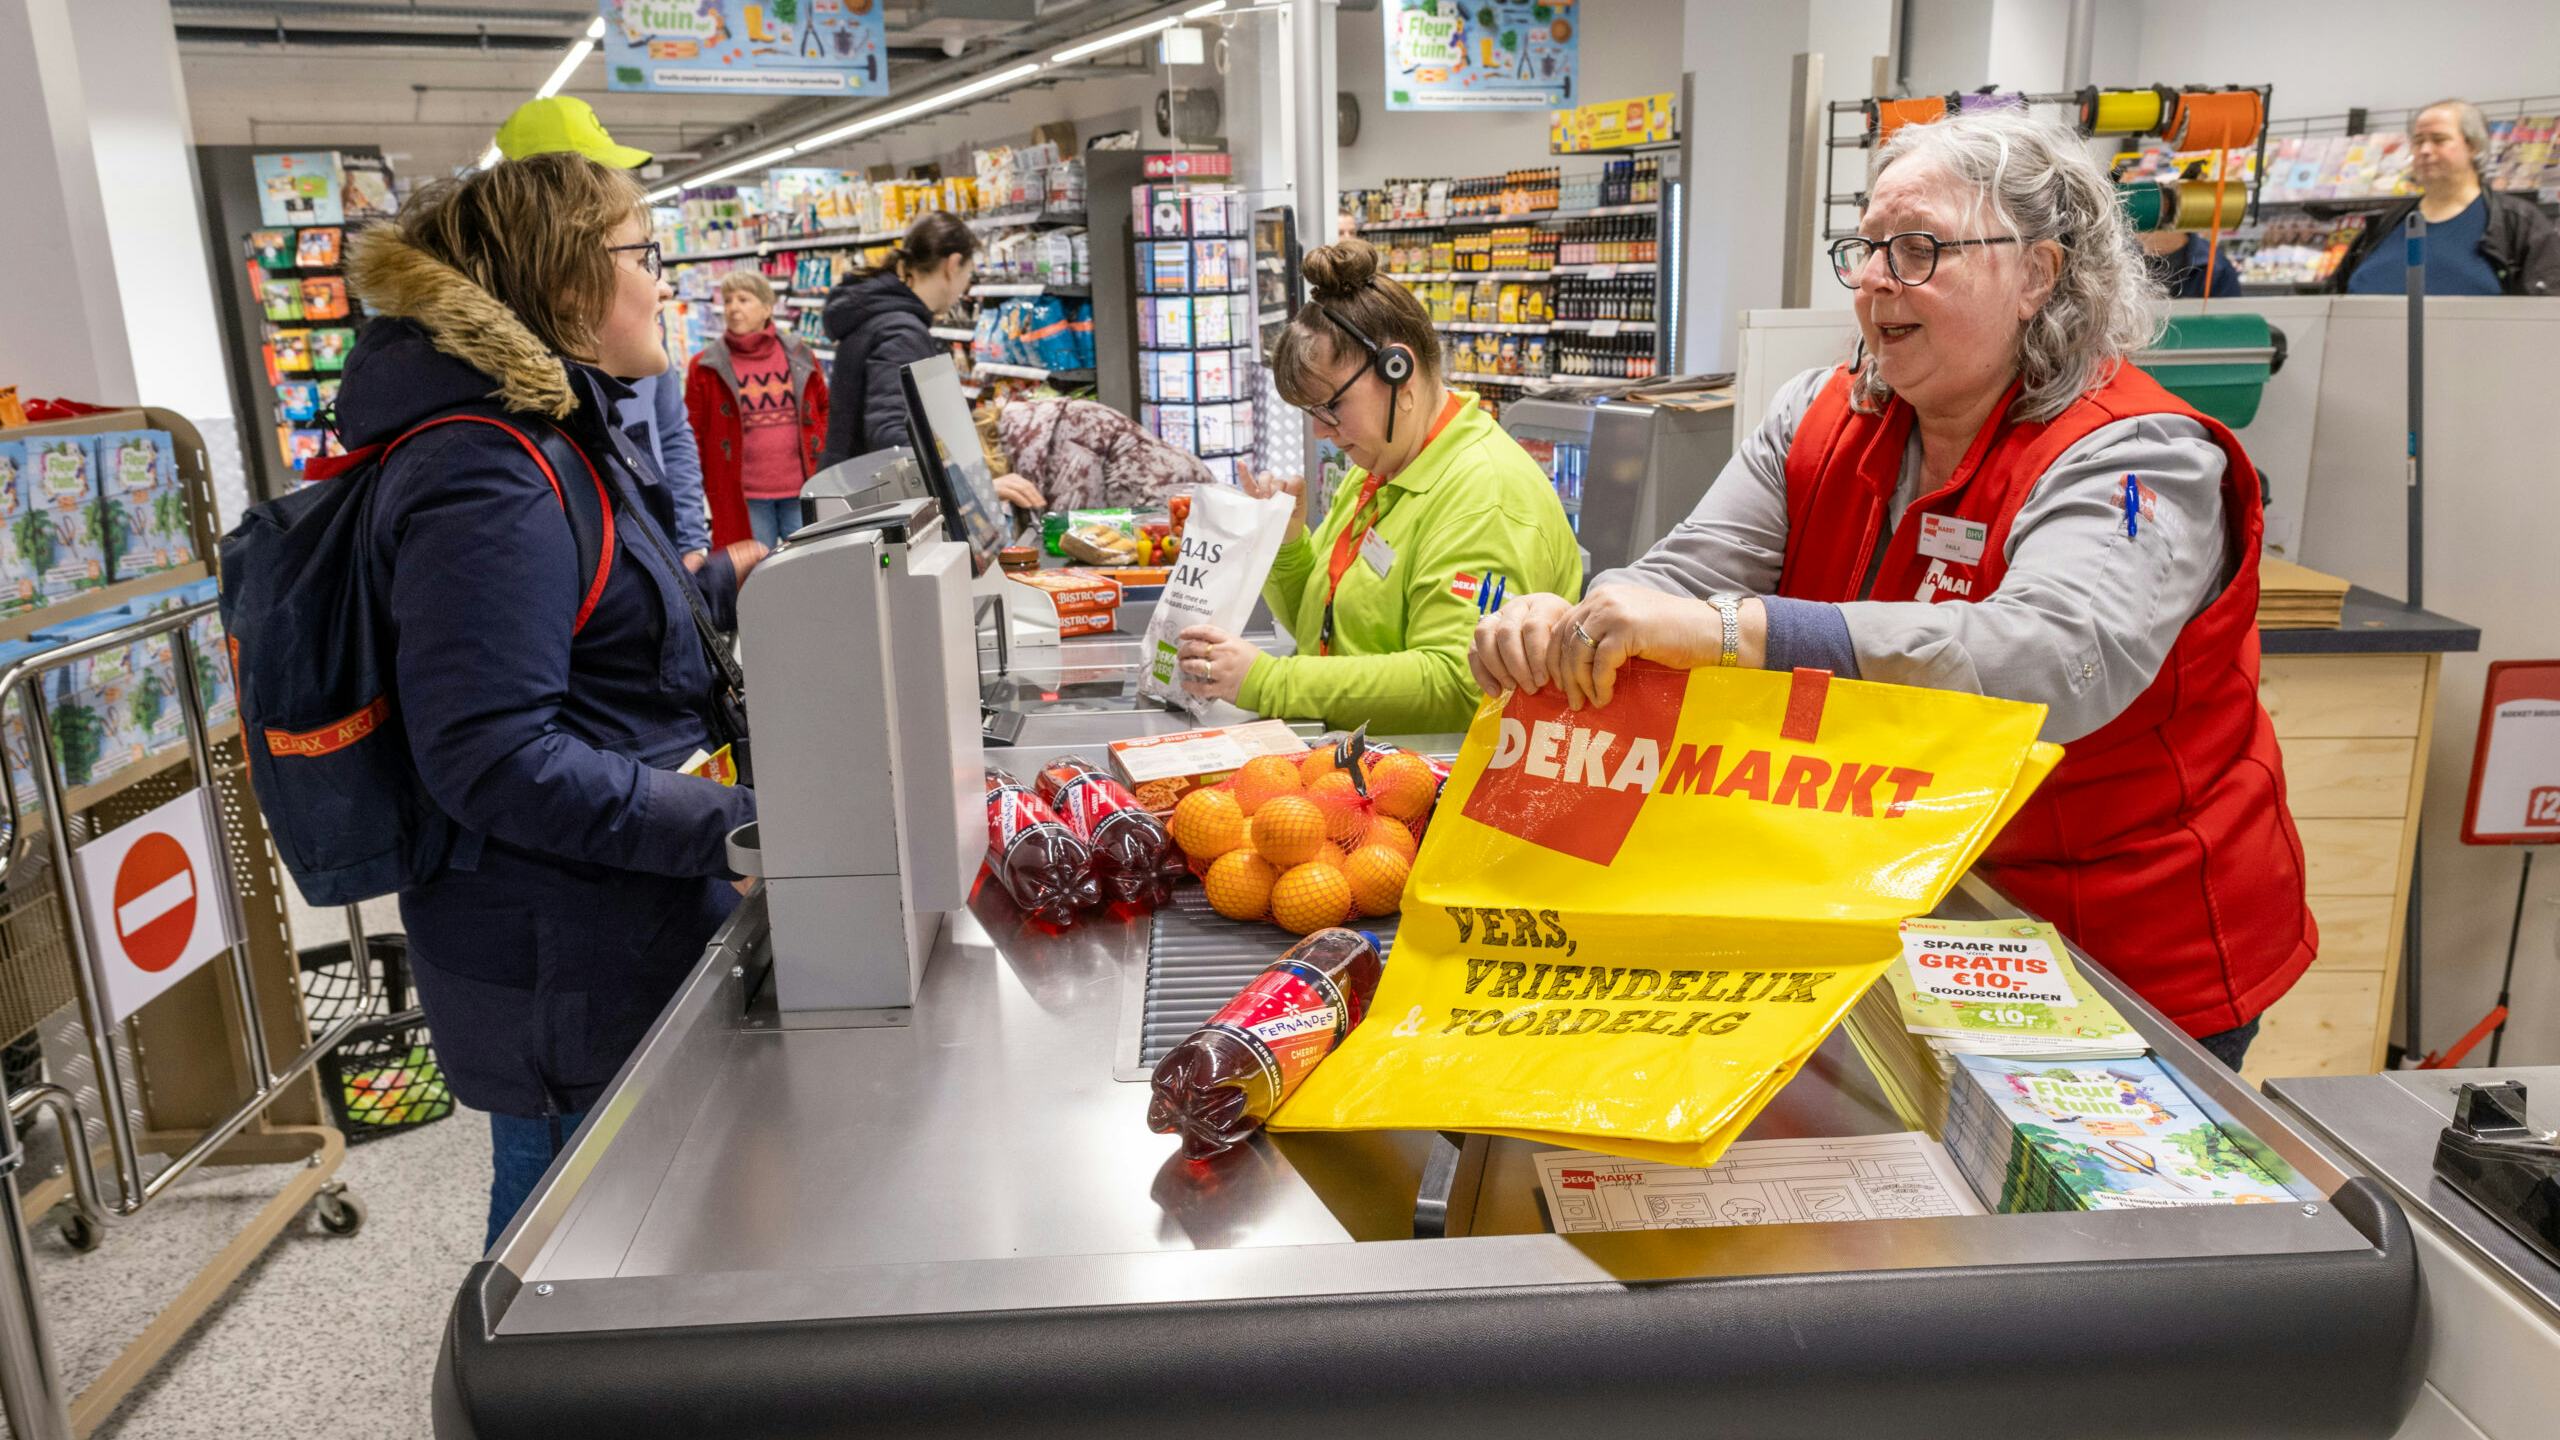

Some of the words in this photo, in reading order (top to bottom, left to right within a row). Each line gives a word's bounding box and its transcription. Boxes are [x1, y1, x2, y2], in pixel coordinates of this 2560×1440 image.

[641, 4, 693, 30] tuin
[1409, 16, 1453, 37] Fleur
[1411, 41, 1447, 58] tuin
[1967, 530, 1983, 539] BHV
[1180, 537, 1223, 563] AAS
[1174, 565, 1208, 590] AK
[1061, 615, 1088, 628] ISTRO
[1488, 716, 1934, 820] DEKAMARKT
[1445, 905, 1578, 958] VERS,
[1923, 939, 1994, 952] SPAAR
[1999, 943, 2028, 954] NU
[1918, 953, 2048, 975] GRATIS
[1320, 979, 1338, 1001] ZERO
[1465, 957, 1836, 1003] VRIENDELIJK
[1930, 986, 2062, 1002] BOODSCHAPPEN
[1258, 1012, 1334, 1037] FERNANDES
[1391, 1004, 1426, 1038] &
[1440, 1007, 1752, 1038] VOORDELIG
[1291, 1045, 1318, 1060] CHERRY
[1254, 1040, 1272, 1065] ZERO
[1270, 1065, 1281, 1097] SUGAR
[2032, 1080, 2115, 1098] Fleur
[2053, 1097, 2124, 1115] tuin
[1562, 1172, 1645, 1185] DEKAMARKT
